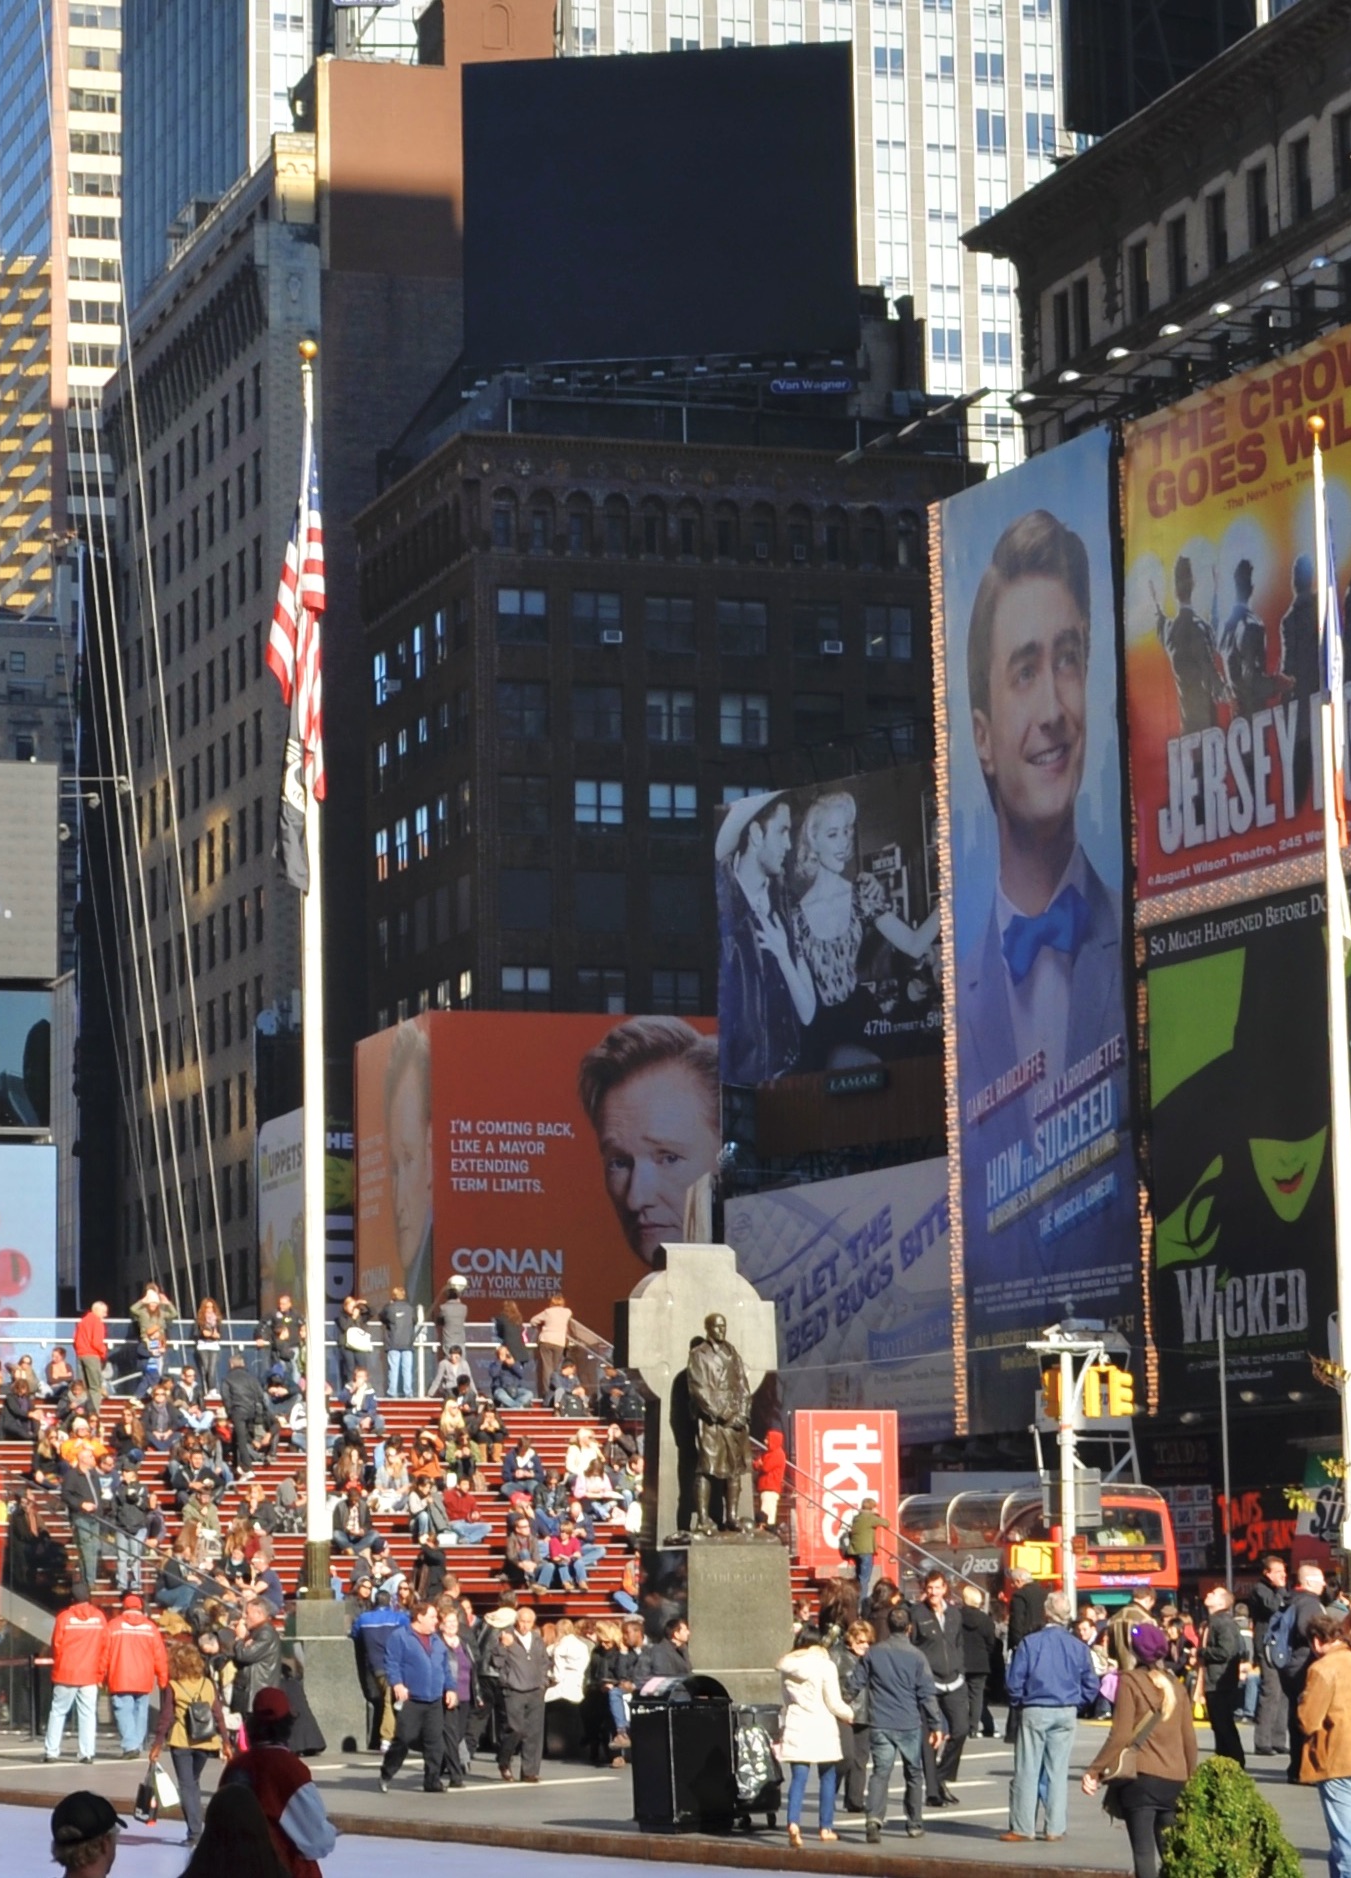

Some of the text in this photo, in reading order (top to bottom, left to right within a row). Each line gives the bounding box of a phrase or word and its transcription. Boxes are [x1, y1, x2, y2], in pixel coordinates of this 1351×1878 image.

[778, 380, 847, 391] Van Wagner
[1147, 432, 1268, 520] GOES
[1158, 699, 1300, 855] JERSEY
[1193, 857, 1228, 876] Wilson
[1230, 844, 1276, 869] Theatre,
[1278, 836, 1303, 852] 245
[1150, 935, 1166, 955] So
[1168, 926, 1202, 951] MUCH
[1204, 911, 1264, 942] HAPPENED
[1265, 901, 1308, 929] BEFORE
[864, 1017, 892, 1036] 47th
[830, 1072, 879, 1089] LAMAR
[996, 1048, 1046, 1101] RADCLIFFE
[451, 1119, 575, 1139] I'M COMING BACK,
[451, 1140, 545, 1154] LIKE A MAYOR
[986, 1139, 1023, 1208] HOW
[1034, 1077, 1113, 1175] SUCCEED
[451, 1159, 529, 1174] EXTENDING
[451, 1178, 545, 1193] TERM LIMITS.
[451, 1248, 563, 1274] CONAN
[800, 1250, 841, 1311] LET
[847, 1202, 894, 1271] THE
[487, 1276, 562, 1290] YORK WEEK
[786, 1306, 829, 1364] BED
[835, 1251, 895, 1328] BUGS
[972, 1556, 1000, 1573] asics
